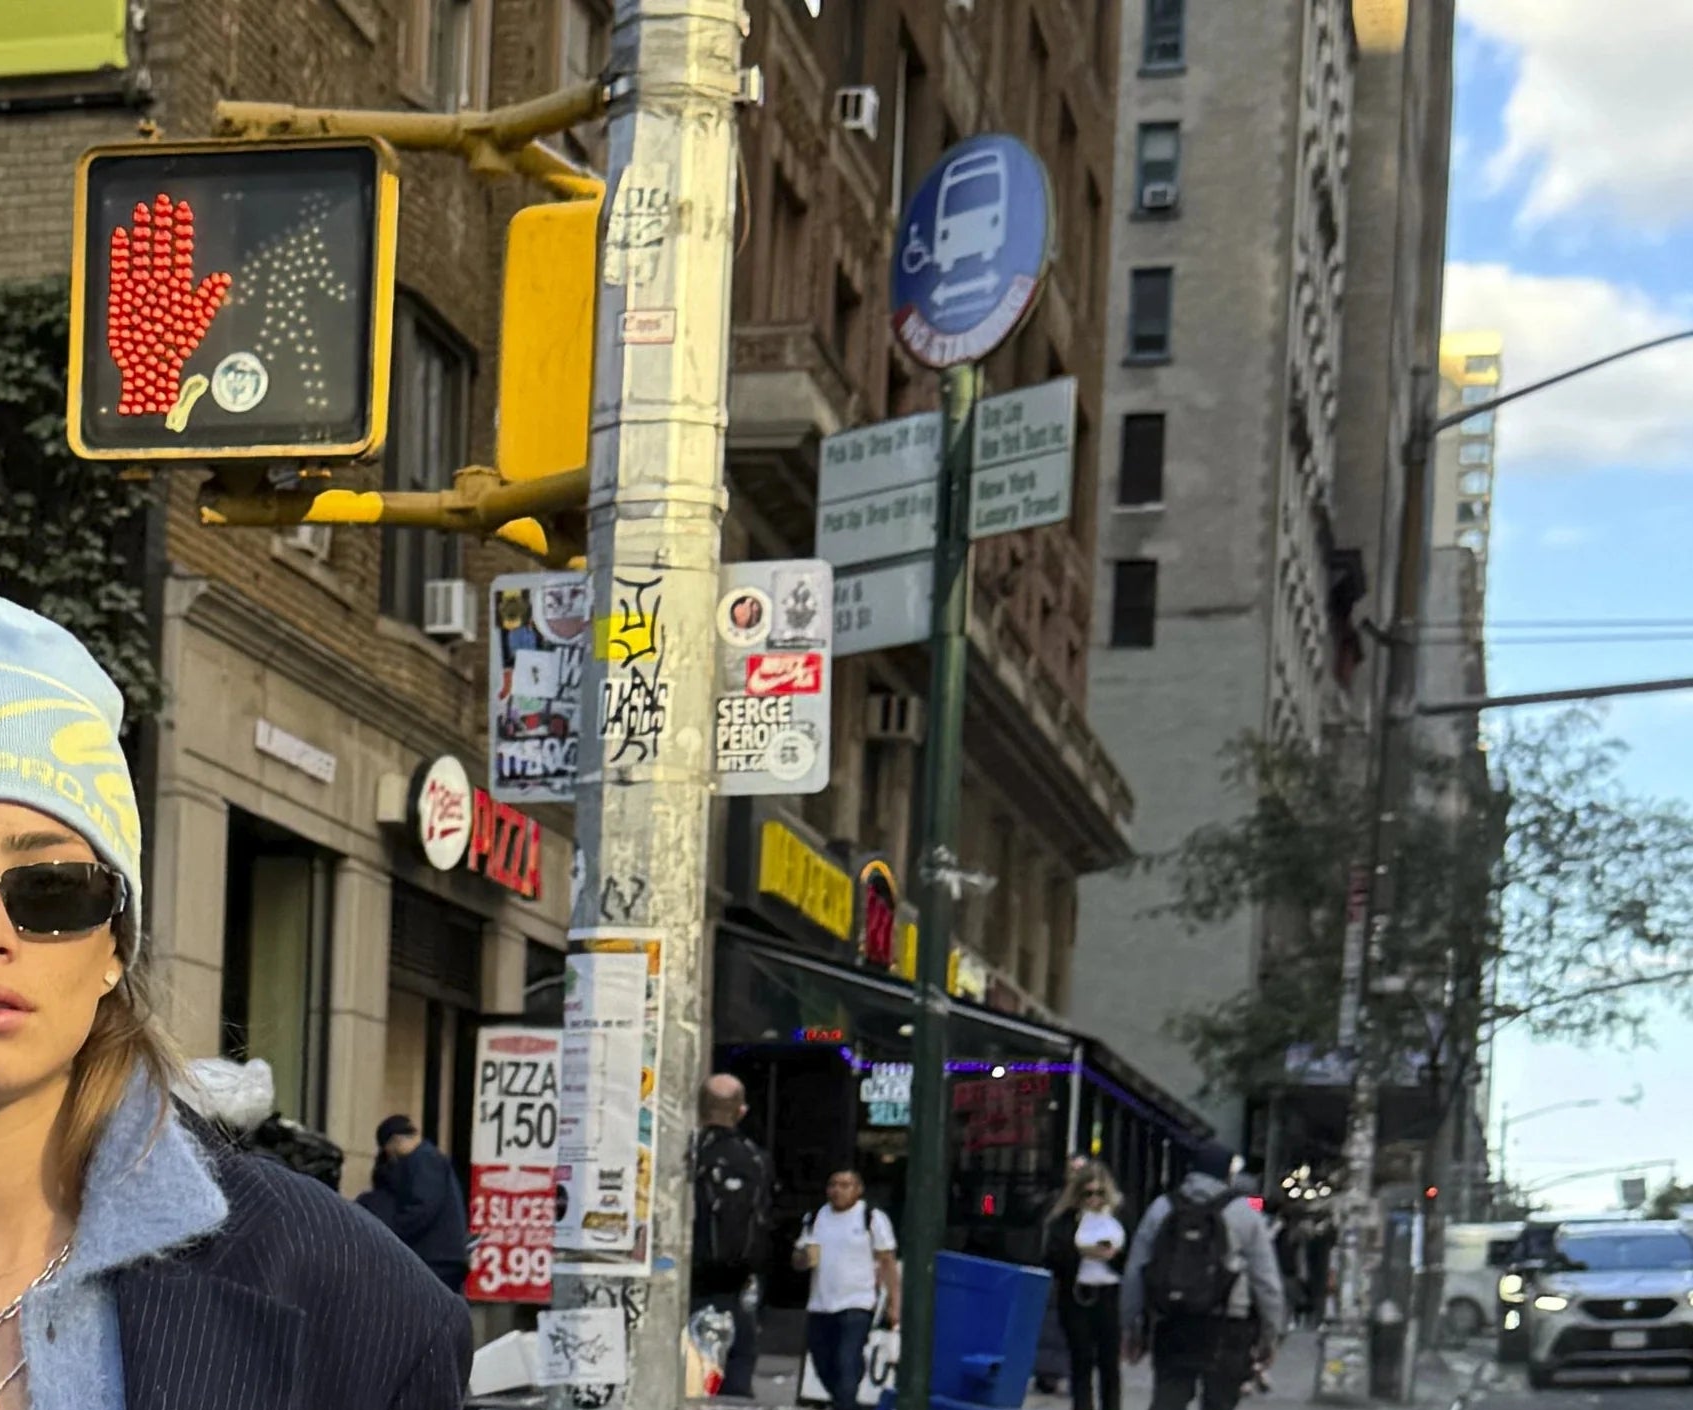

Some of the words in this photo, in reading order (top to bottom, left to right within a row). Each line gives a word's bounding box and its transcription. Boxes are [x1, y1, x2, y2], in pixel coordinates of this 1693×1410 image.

[717, 695, 792, 725] SERGE
[468, 785, 543, 901] PIZZA
[481, 1060, 558, 1098] PIZZA
[479, 1101, 558, 1158] $1.50
[471, 1195, 485, 1226] 2
[489, 1195, 555, 1228] SLICES
[470, 1246, 552, 1293] $3.99
